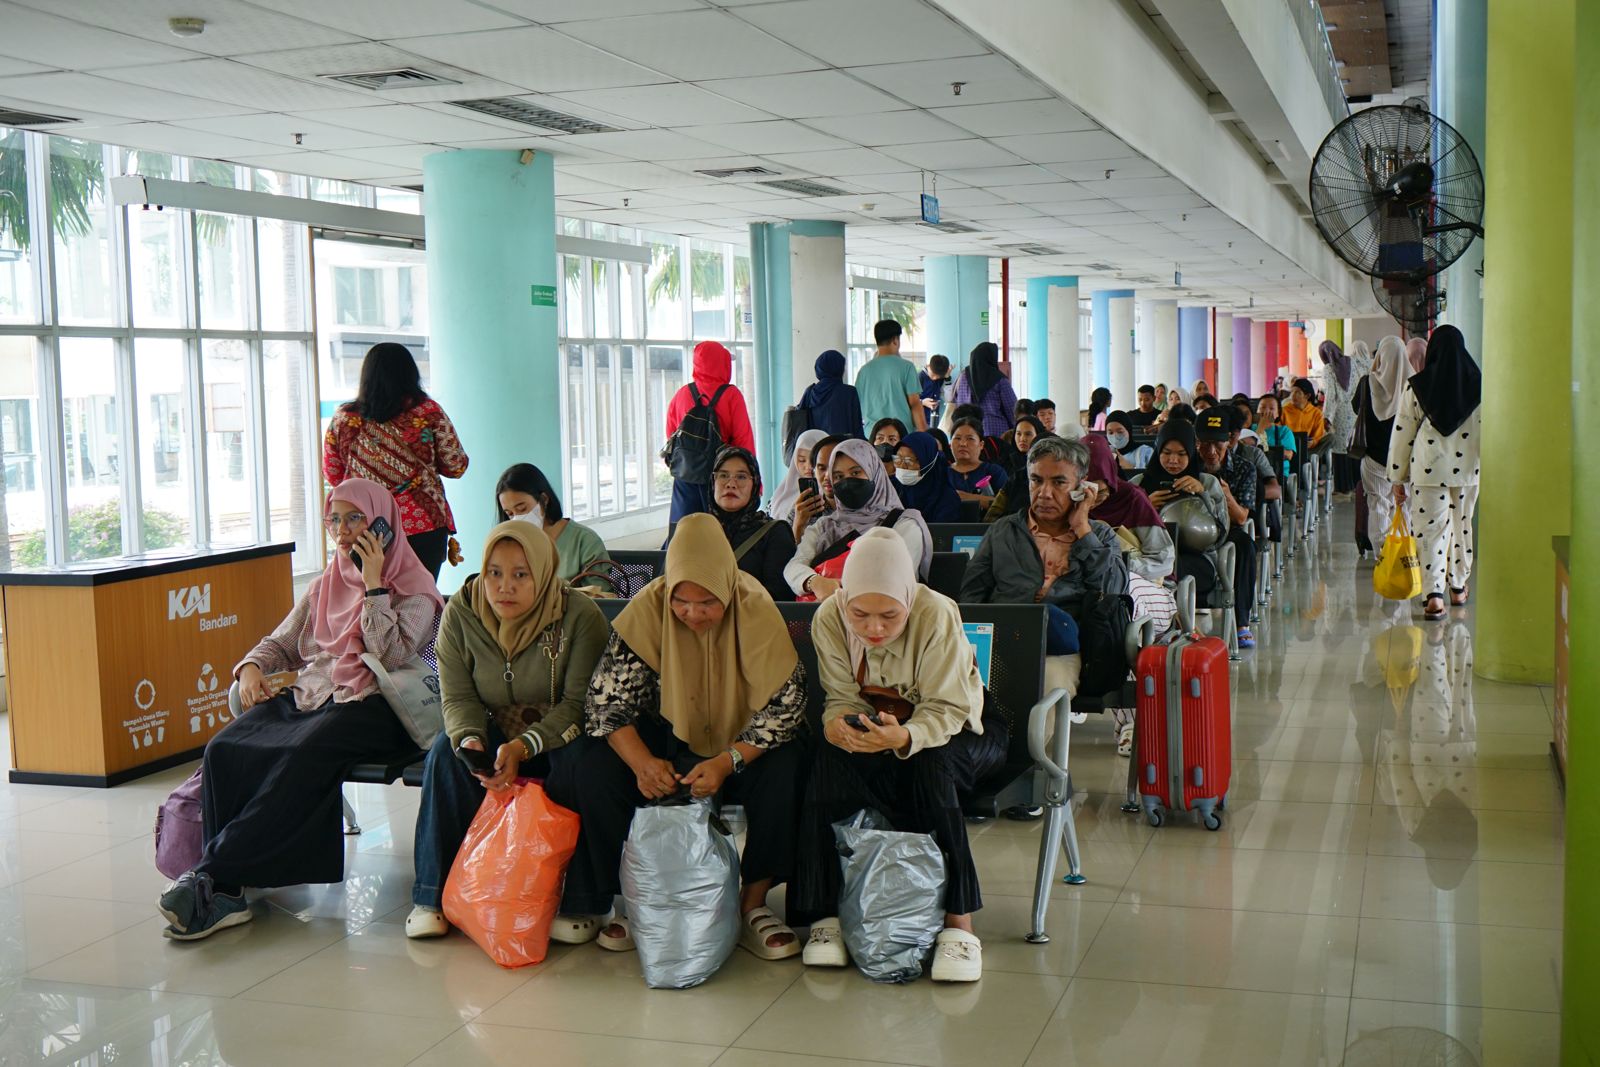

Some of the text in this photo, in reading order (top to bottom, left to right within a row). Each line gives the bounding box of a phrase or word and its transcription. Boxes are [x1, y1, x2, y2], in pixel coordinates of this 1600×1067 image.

[168, 583, 211, 621] KAI
[200, 613, 238, 632] Bandara
[187, 695, 208, 706] Sampah
[191, 699, 227, 714] Organic Waste
[123, 716, 143, 727] Sampah
[151, 719, 166, 727] Waste
